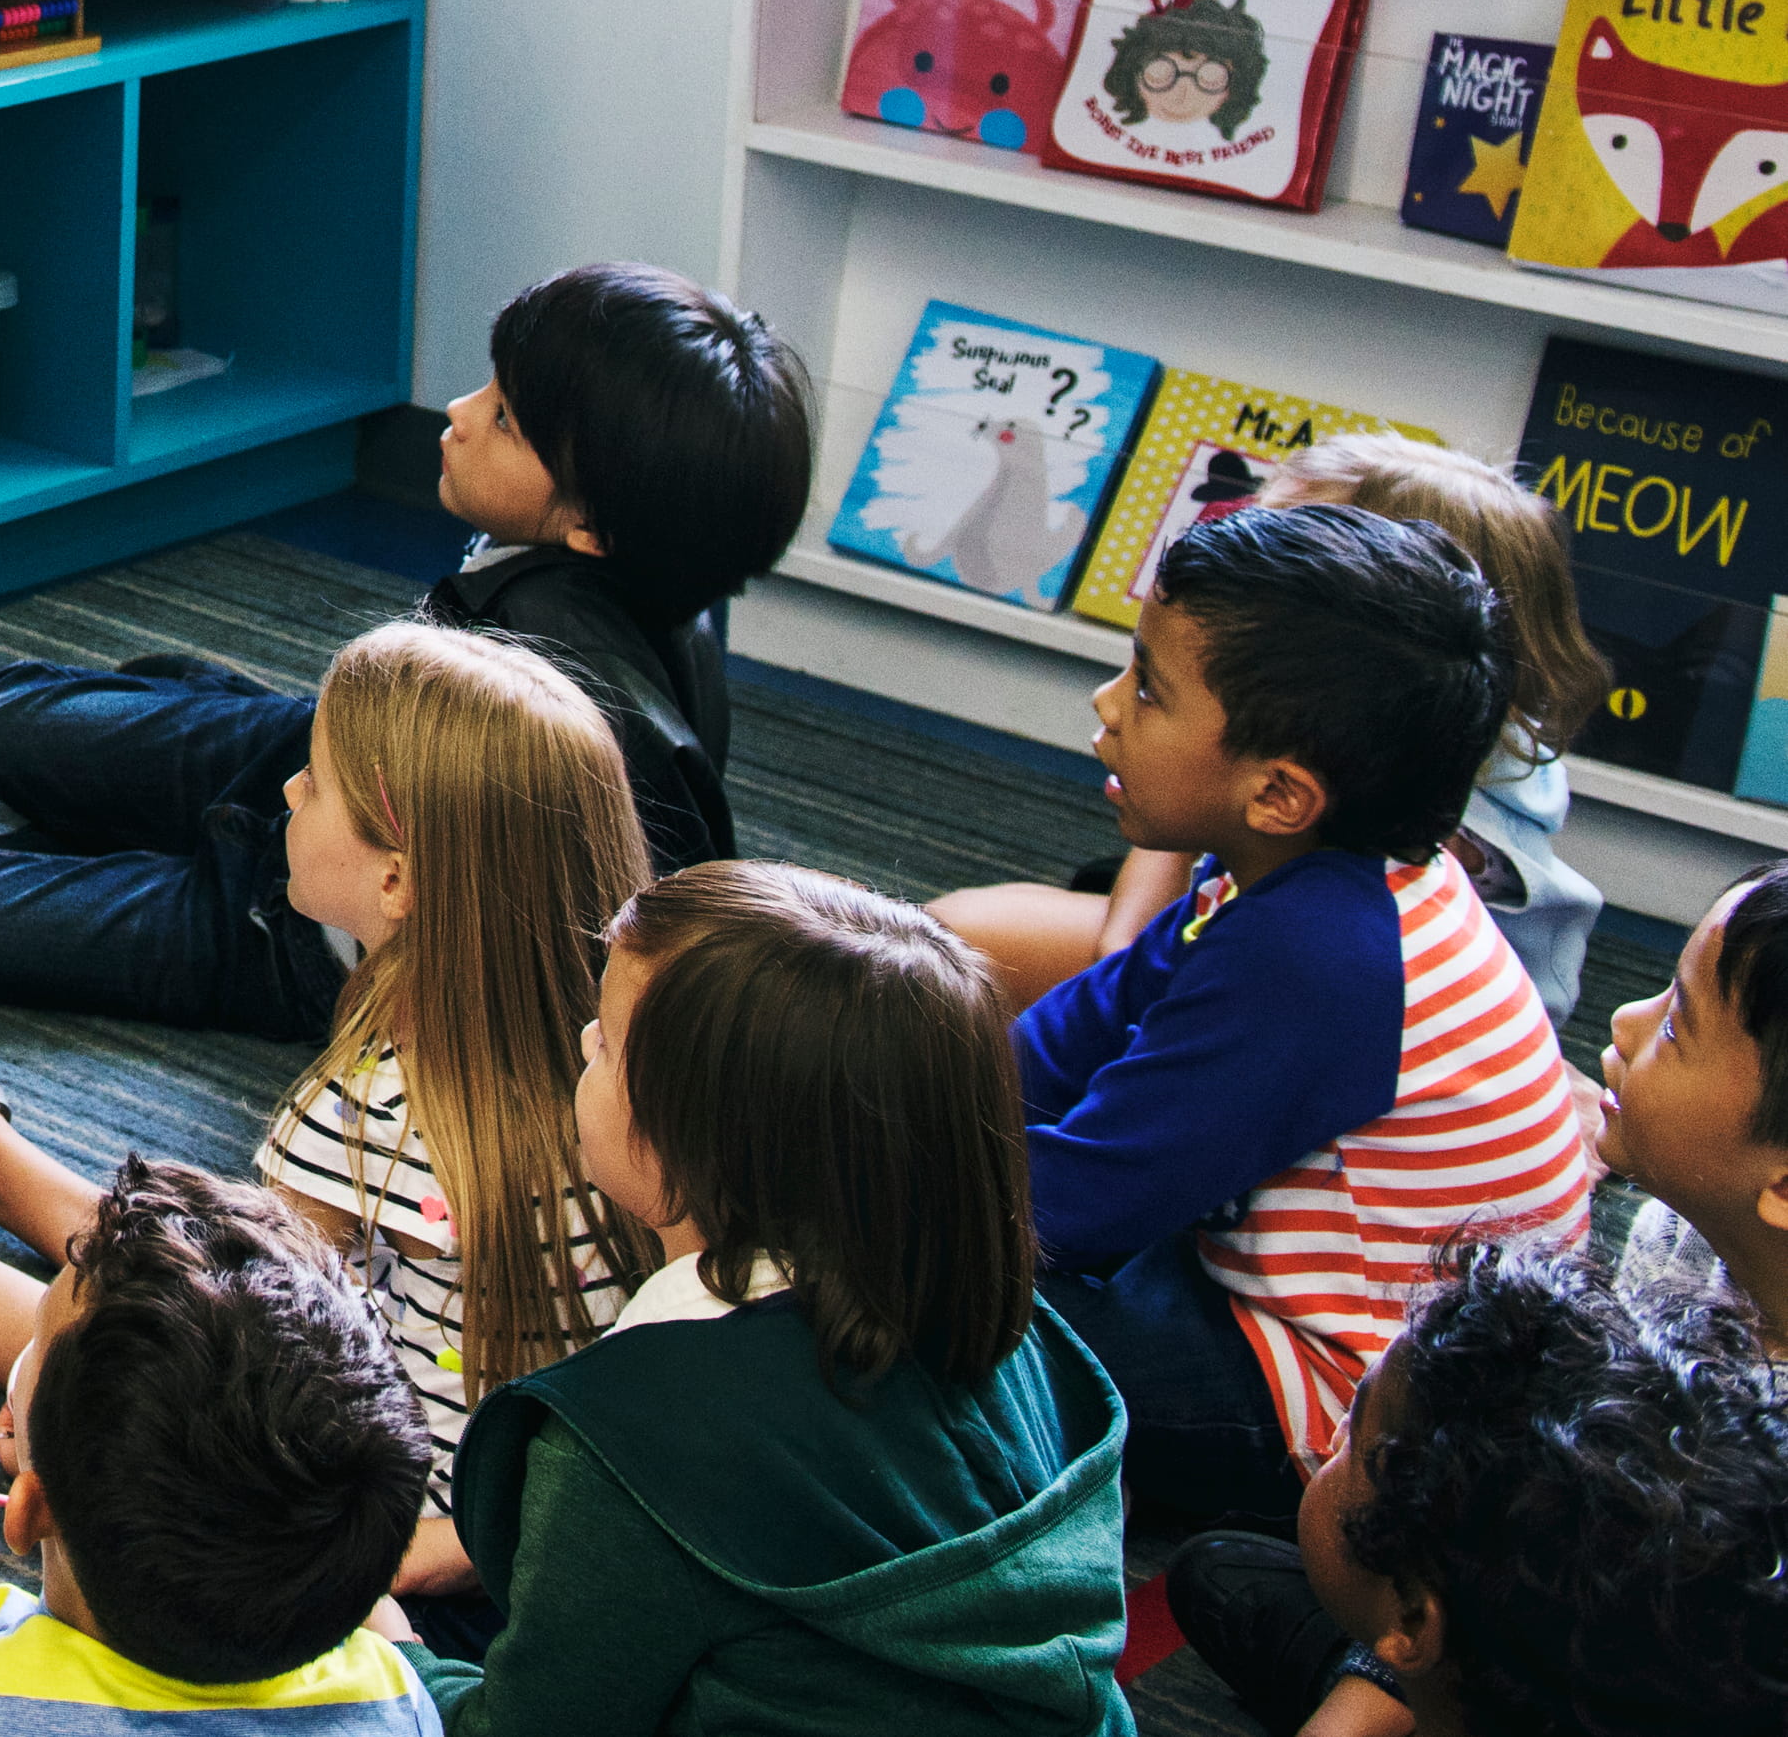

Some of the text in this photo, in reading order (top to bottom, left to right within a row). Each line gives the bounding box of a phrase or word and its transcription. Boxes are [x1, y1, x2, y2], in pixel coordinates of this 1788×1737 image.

[1438, 46, 1528, 87] MAGIC
[1441, 76, 1535, 120] NIGHT
[952, 336, 1051, 373] Suspicious
[973, 367, 1019, 395] Seal
[1553, 381, 1773, 461] Because of
[1535, 457, 1749, 569] MEOW
